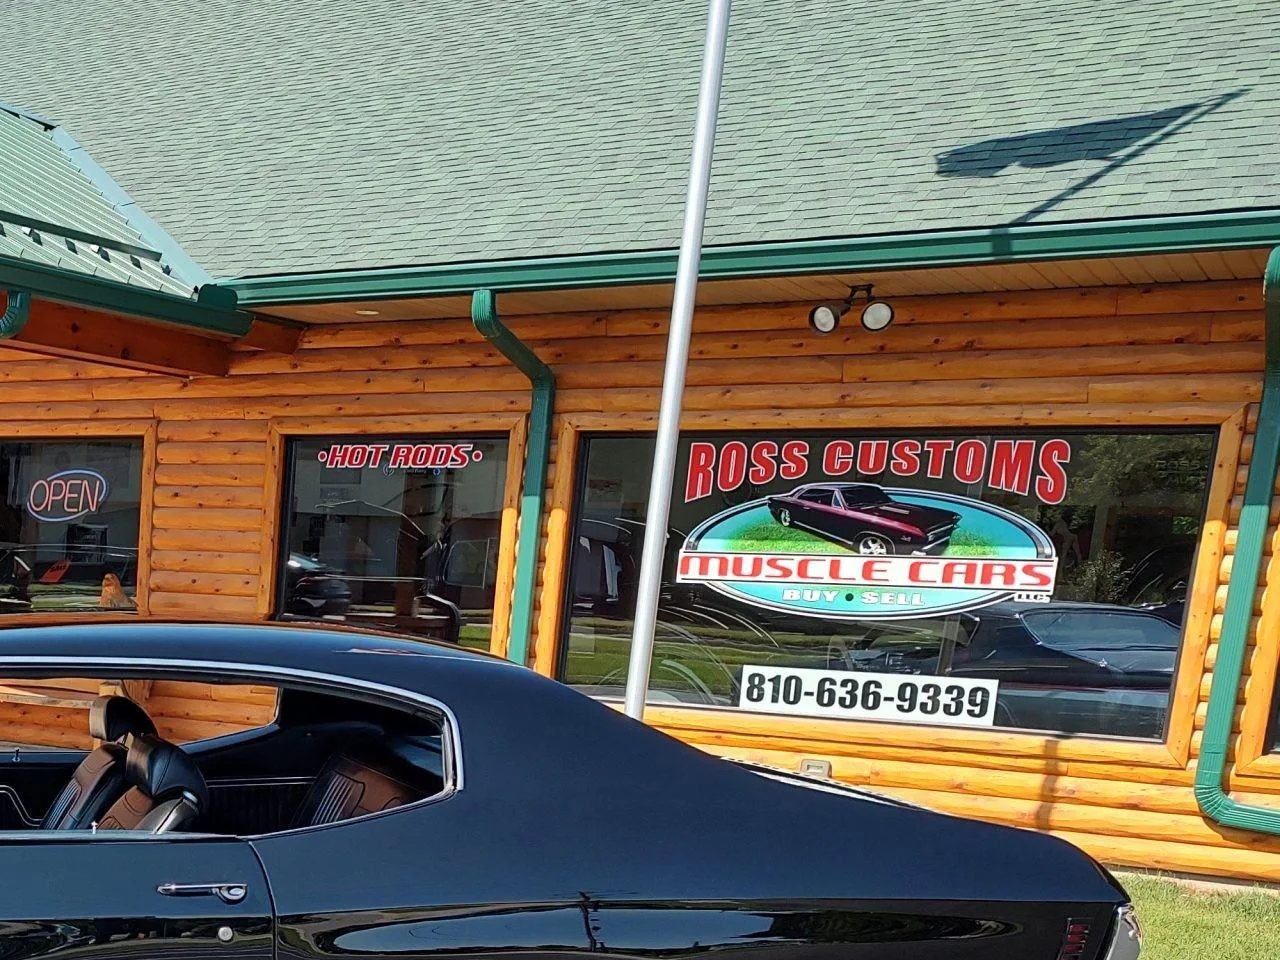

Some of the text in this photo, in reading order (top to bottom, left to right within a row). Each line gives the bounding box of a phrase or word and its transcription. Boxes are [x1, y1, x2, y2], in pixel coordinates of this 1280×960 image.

[326, 444, 474, 469] HOT RODS
[684, 438, 1072, 504] ROSS CUSTOMS
[30, 480, 100, 512] OPEN
[679, 554, 1053, 587] MUSCLE CARS
[782, 589, 926, 607] BUY SELL
[746, 672, 990, 719] 810-636-9339
